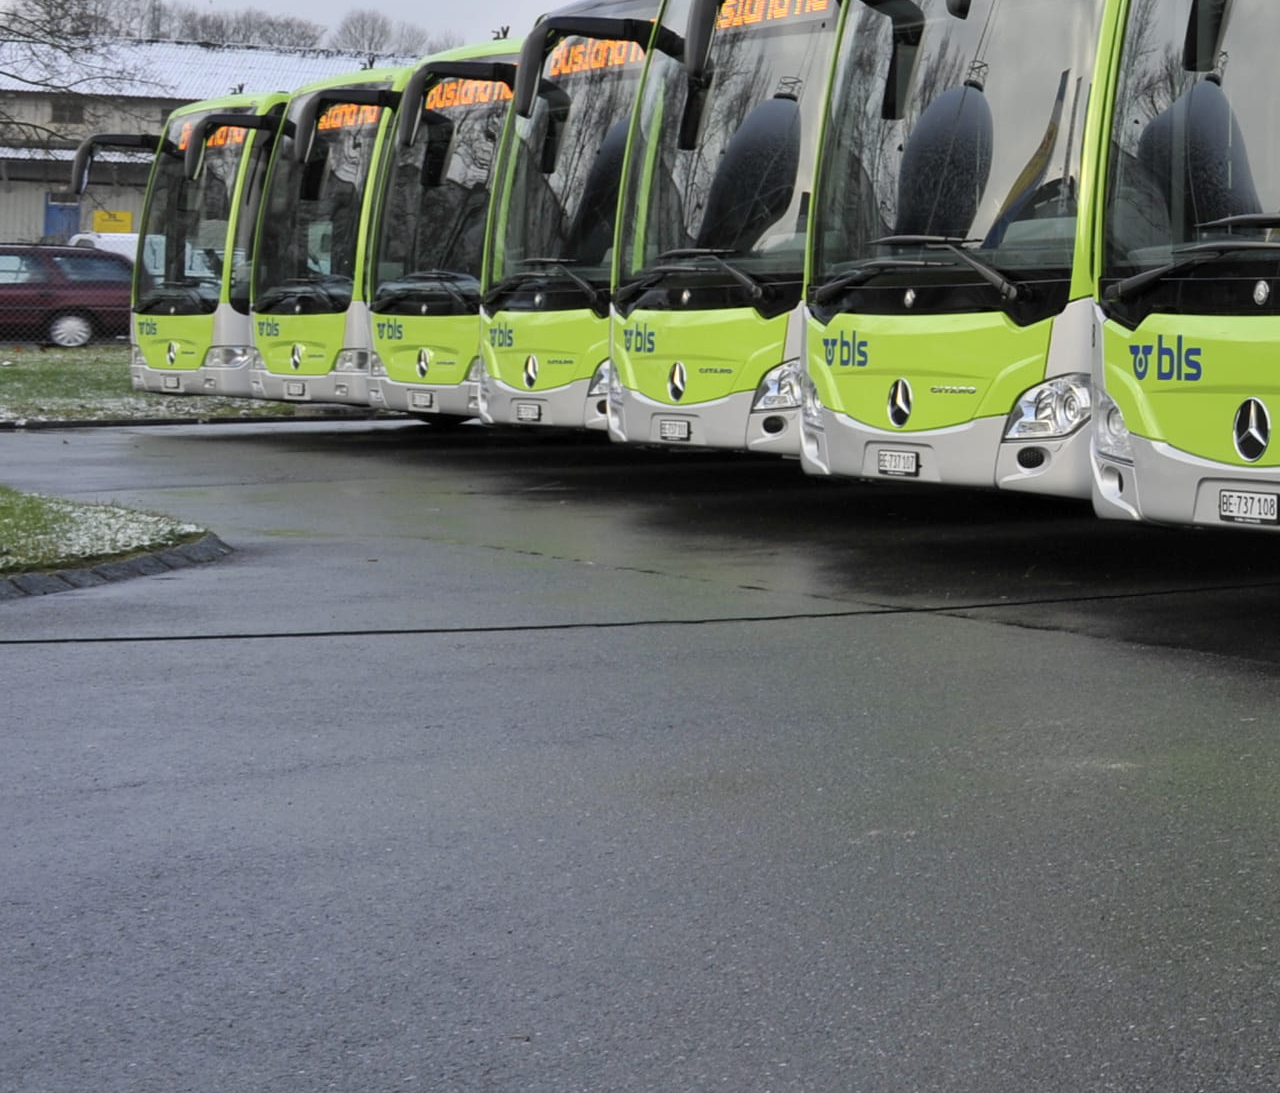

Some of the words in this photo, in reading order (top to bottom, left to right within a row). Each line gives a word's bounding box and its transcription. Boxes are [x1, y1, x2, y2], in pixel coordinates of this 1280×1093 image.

[387, 318, 403, 340] bls
[498, 323, 513, 347] bls
[635, 323, 655, 353] bls
[840, 330, 868, 367] bls
[1157, 334, 1202, 381] bls
